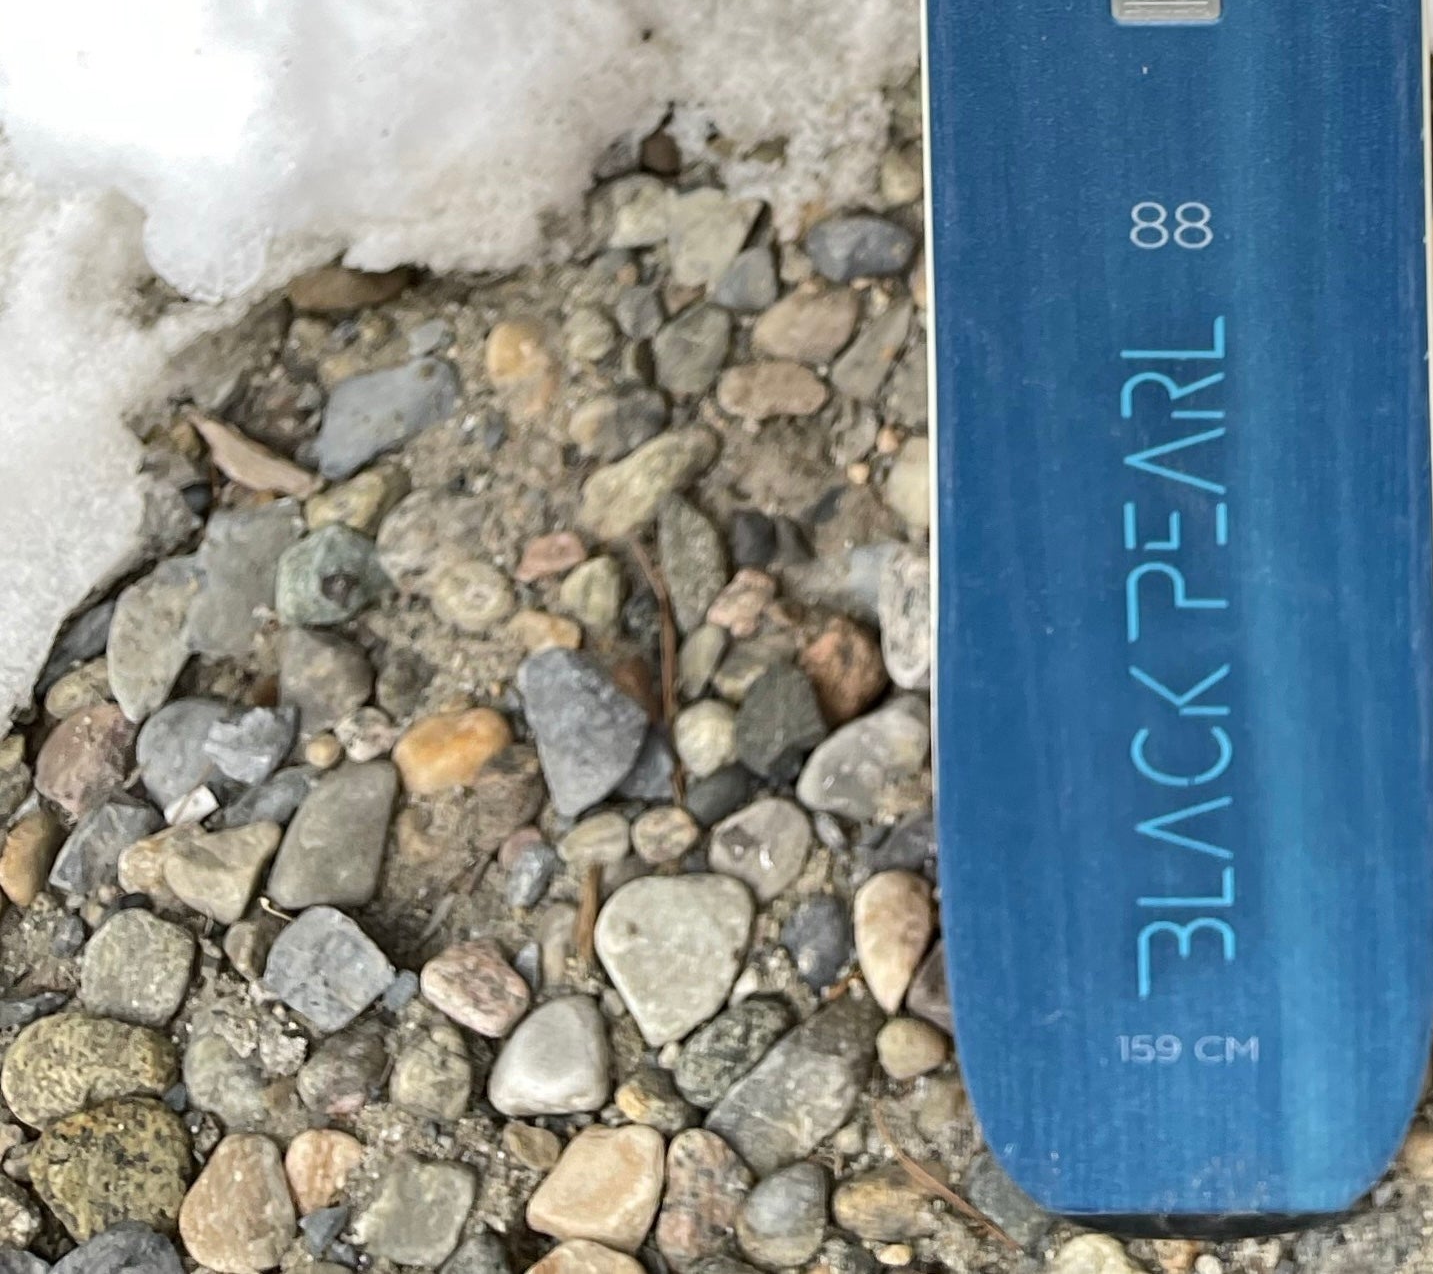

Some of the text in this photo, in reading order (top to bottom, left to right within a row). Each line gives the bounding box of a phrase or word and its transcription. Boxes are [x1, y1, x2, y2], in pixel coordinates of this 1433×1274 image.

[1129, 201, 1214, 249] 88
[1120, 314, 1237, 1000] BLACK PEARL
[1116, 1034, 1260, 1065] 159 CM
